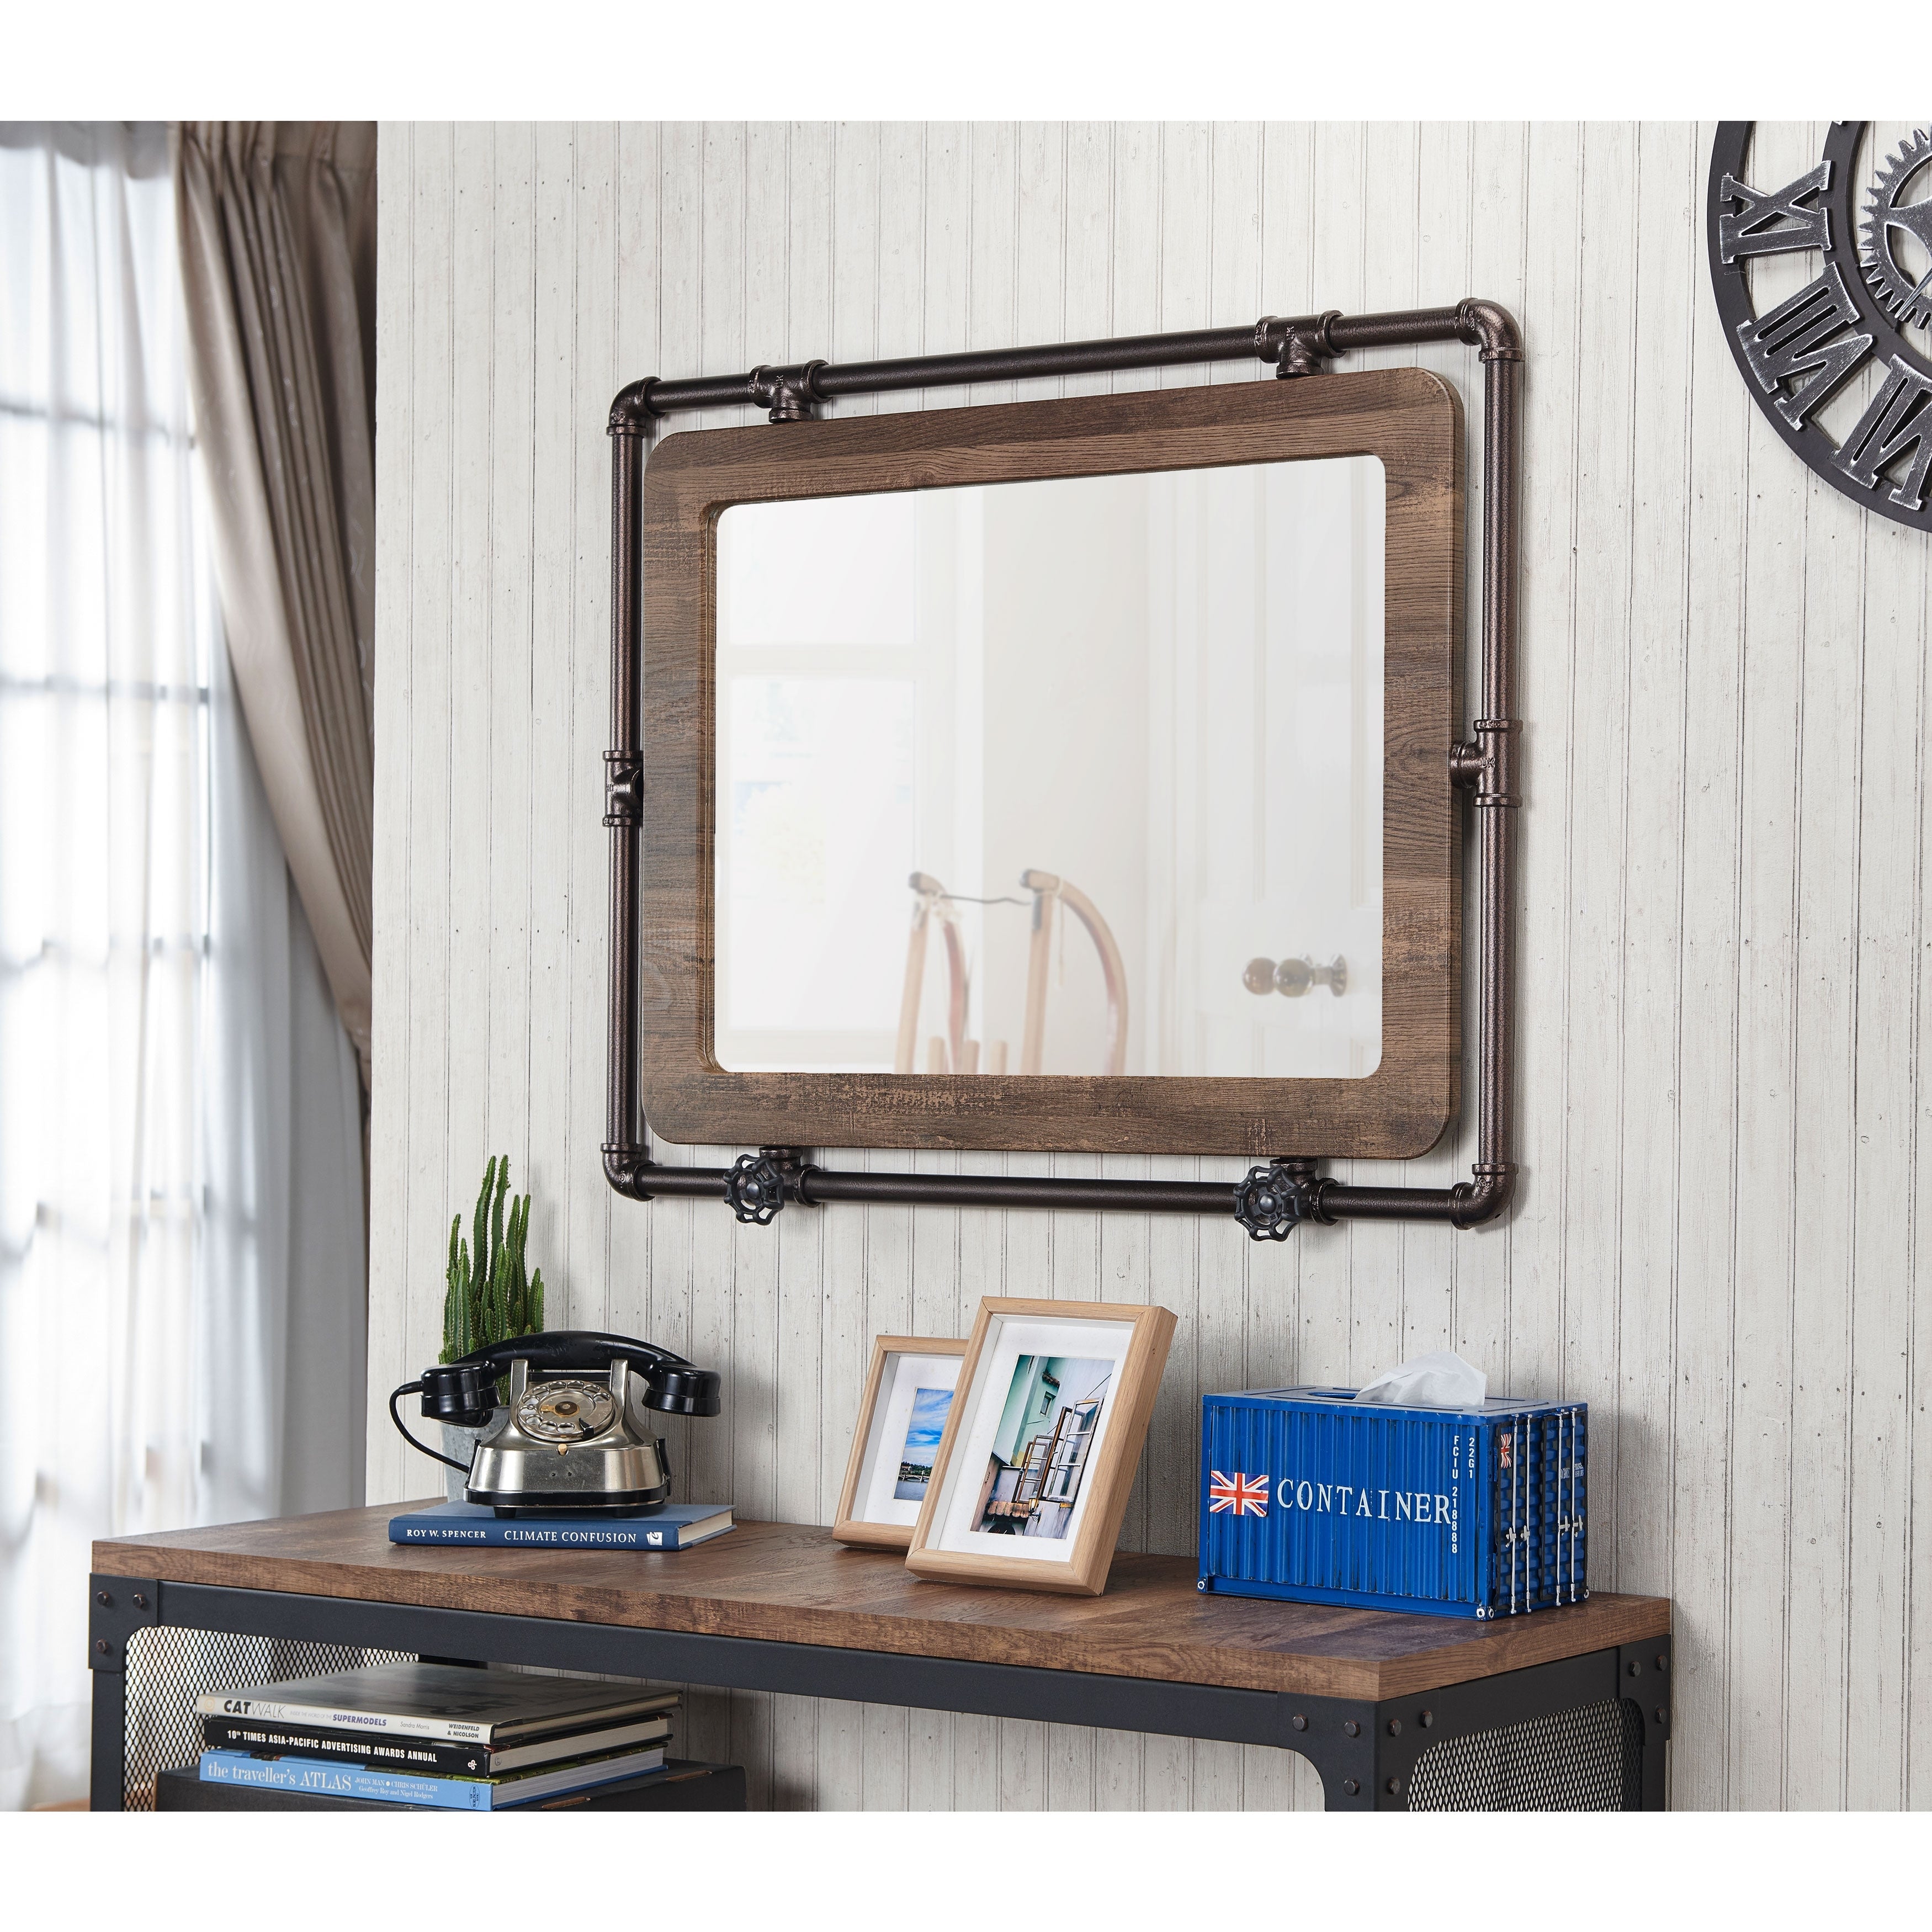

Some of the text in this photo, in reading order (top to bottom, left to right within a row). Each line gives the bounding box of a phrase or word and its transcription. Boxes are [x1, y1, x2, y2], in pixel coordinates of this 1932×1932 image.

[1277, 1478, 1451, 1524] CONTAINER
[442, 1530, 486, 1538] SPENCER
[504, 1530, 636, 1543] CLIMATE CONFUSION
[333, 1713, 387, 1726] SUPERMODELS
[448, 1723, 480, 1732] WEIDENFELD
[243, 1732, 266, 1743] TIMES
[268, 1734, 319, 1749] ASIA-PACIFIC
[321, 1740, 371, 1755] ADVERTISING
[374, 1746, 405, 1759] AWARDS
[407, 1750, 437, 1763] ANNUAL
[208, 1761, 352, 1791] the traveller's ATLAS
[355, 1777, 371, 1785] JOHN
[410, 1782, 438, 1792] SCHÜLER
[359, 1786, 379, 1795] Geoffrey
[400, 1790, 413, 1798] Nigel
[414, 1791, 433, 1800] Rodgers
